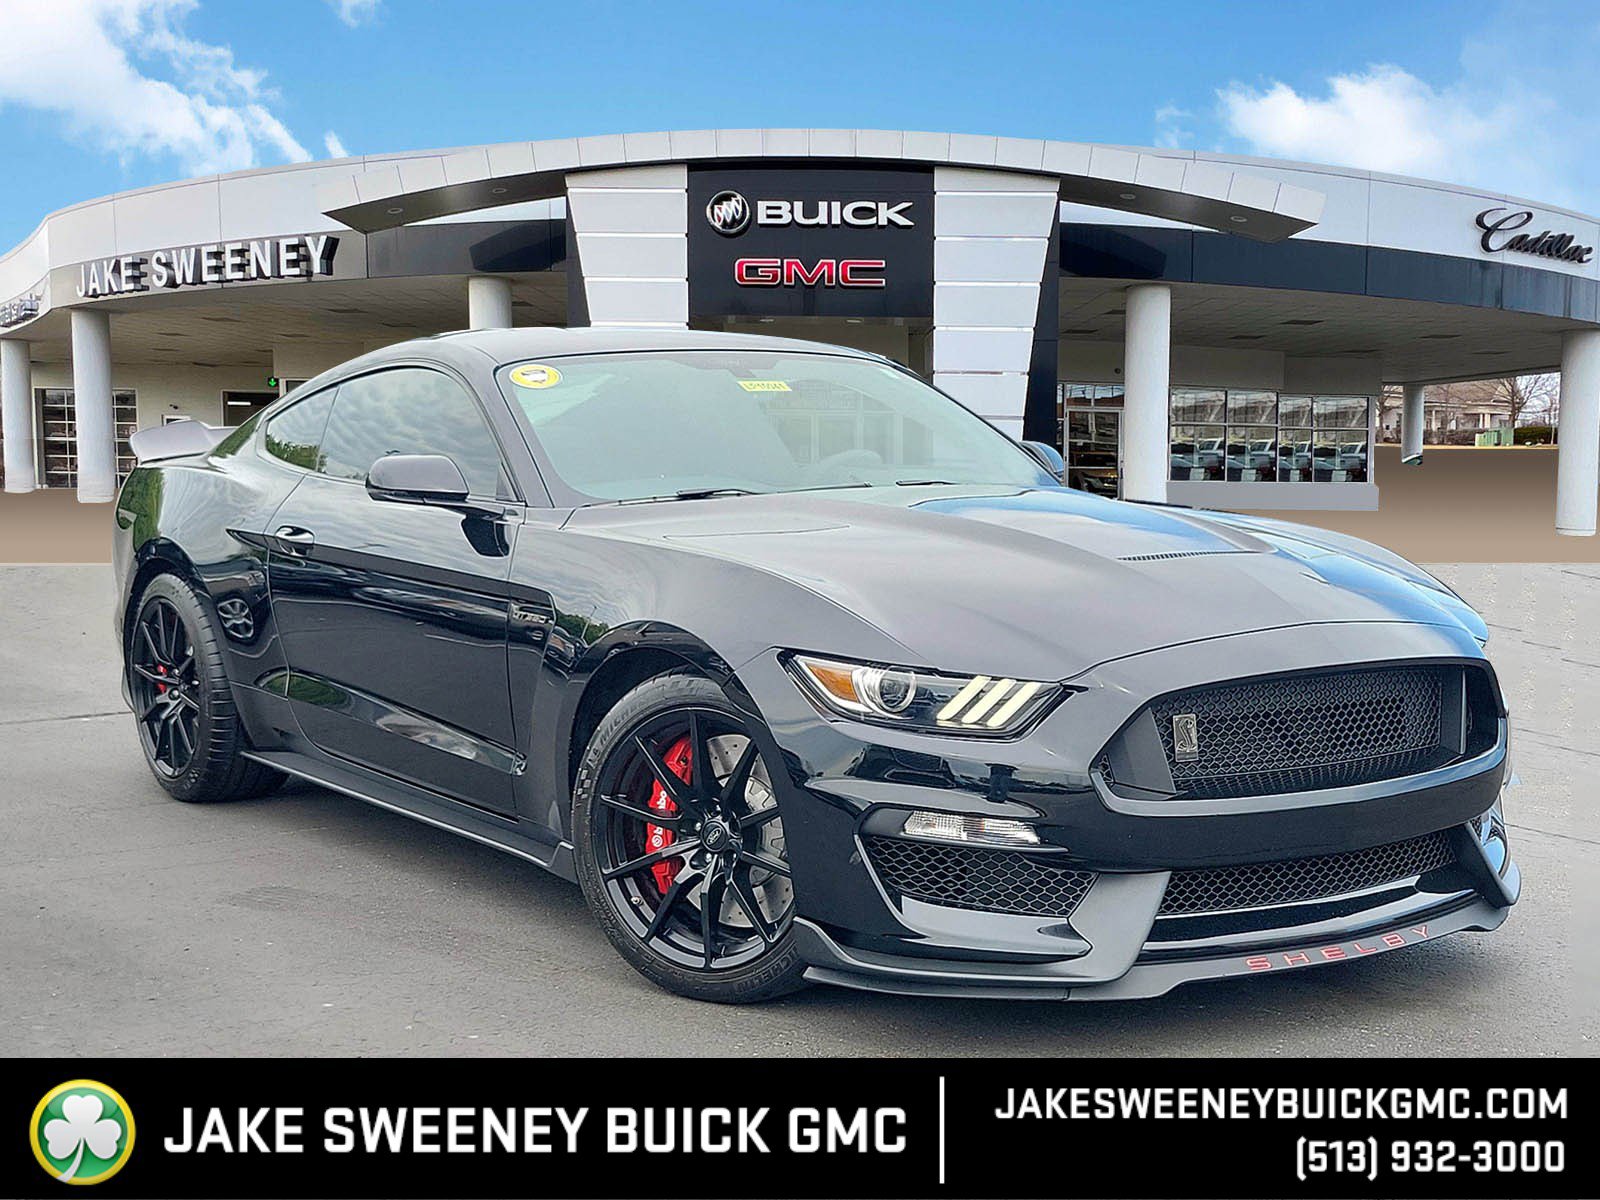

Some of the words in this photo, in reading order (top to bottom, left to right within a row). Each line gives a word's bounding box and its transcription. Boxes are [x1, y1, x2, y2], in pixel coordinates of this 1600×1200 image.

[757, 201, 915, 226] BUICK
[1475, 207, 1593, 263] Cadillac
[76, 256, 143, 298] JAKE
[151, 235, 335, 288] SWEENEY
[734, 258, 886, 287] GMC
[1245, 924, 1430, 971] SHELBY
